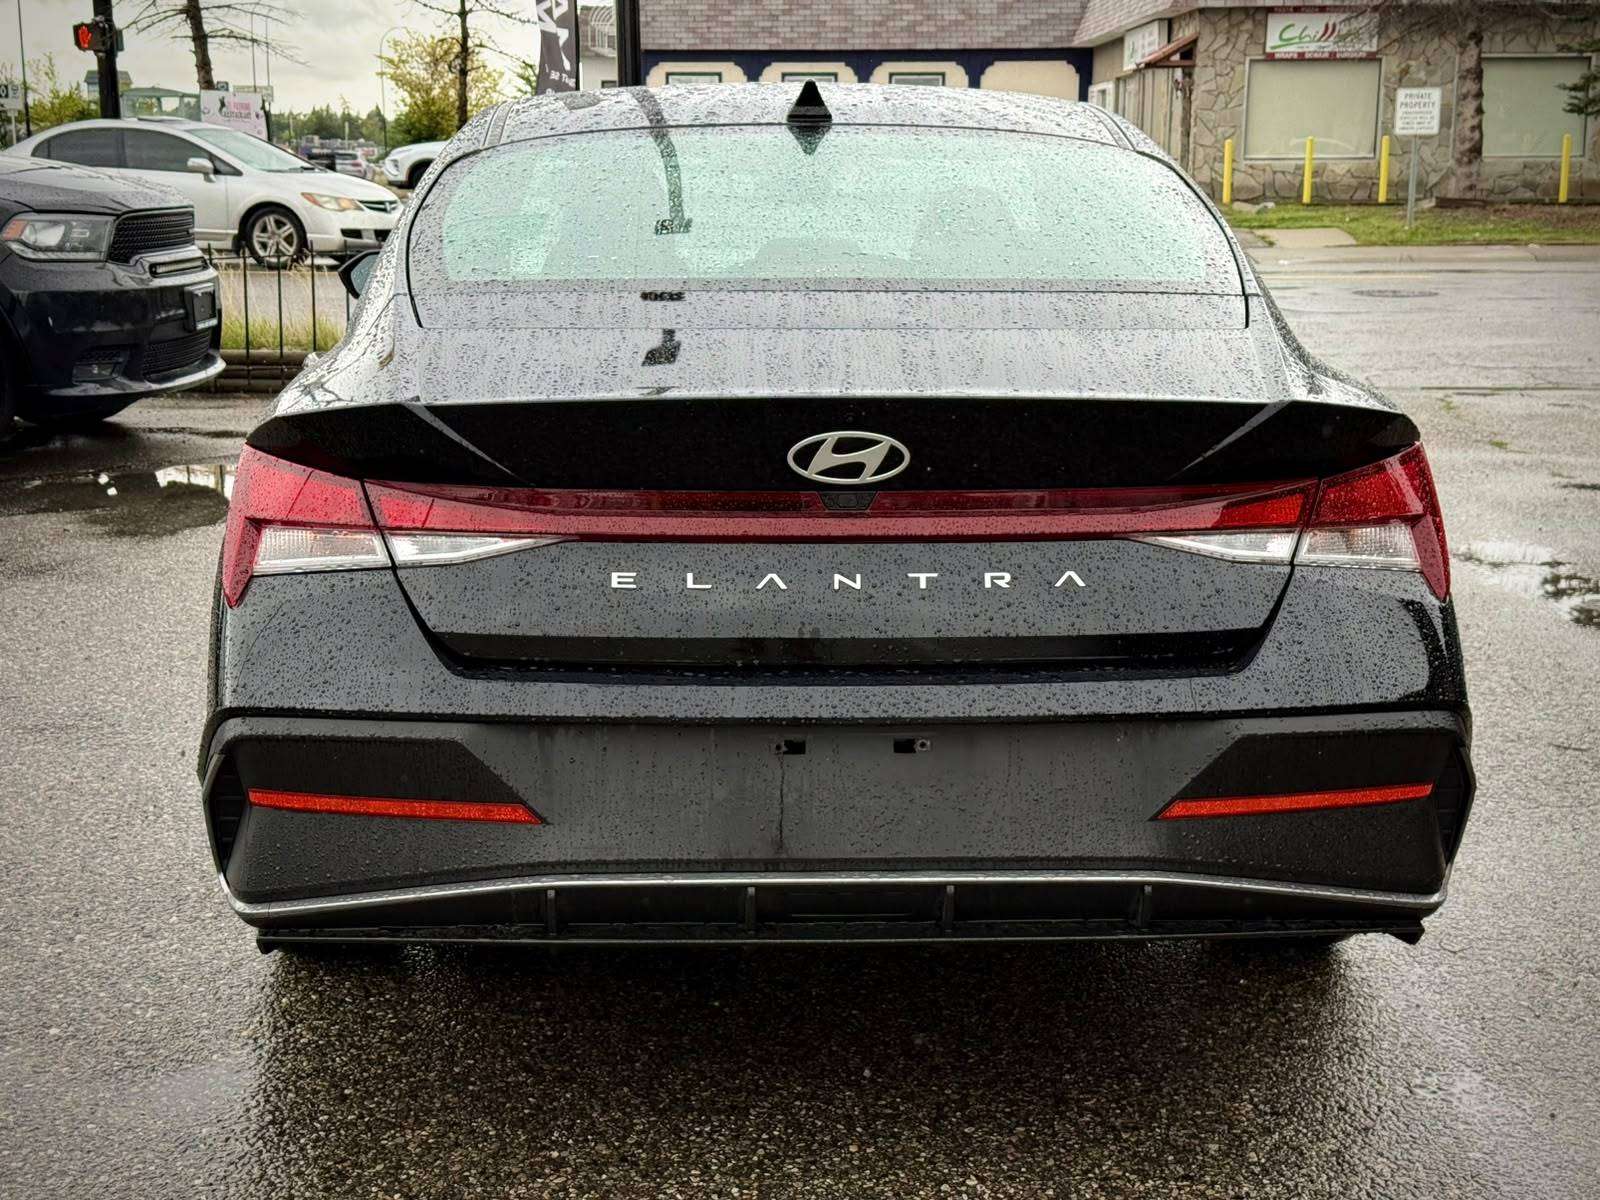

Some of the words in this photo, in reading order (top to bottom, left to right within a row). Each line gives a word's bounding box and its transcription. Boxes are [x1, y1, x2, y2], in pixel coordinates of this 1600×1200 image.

[1404, 91, 1433, 100] PRIVATE
[1399, 101, 1436, 110] PROPERTY
[610, 570, 1087, 591] ELANTRA
